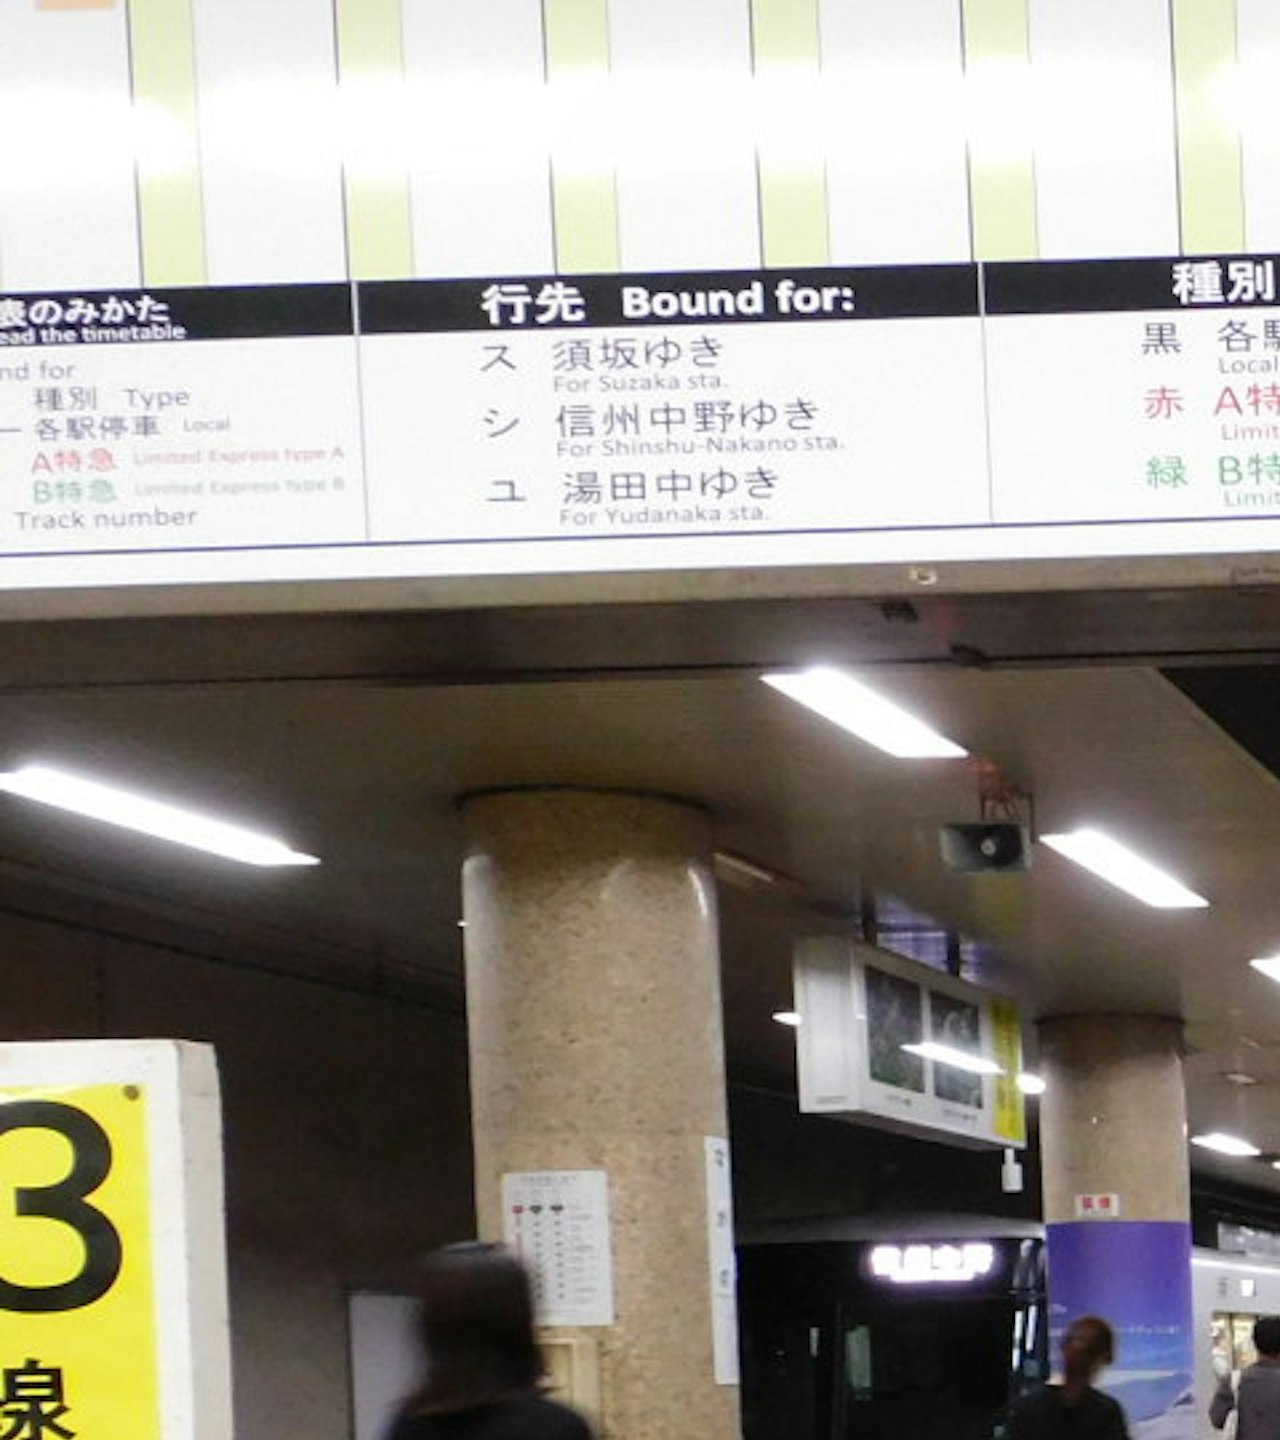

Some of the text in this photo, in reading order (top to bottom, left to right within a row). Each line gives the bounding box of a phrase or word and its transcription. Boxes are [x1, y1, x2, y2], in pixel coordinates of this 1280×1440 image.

[1172, 260, 1276, 304] 種別
[480, 280, 855, 325] 行先 Bound for:
[40, 327, 76, 344] the
[81, 323, 187, 343] timetable
[1142, 323, 1182, 354] 黒
[480, 336, 722, 372] ス 須坂ゆき
[553, 376, 591, 393] For
[600, 373, 680, 392] Suzaka
[483, 398, 818, 438] シ 信州中野ゆき
[1145, 387, 1183, 419] 赤
[557, 441, 593, 458] For
[602, 437, 798, 457] Shinshu-Nakano
[563, 467, 779, 505] 湯田中ゆき
[1146, 456, 1188, 489] 緑
[17, 508, 198, 531] Track number
[560, 509, 597, 526] For
[605, 505, 721, 525] Yudanaka
[0, 1100, 123, 1313] 3
